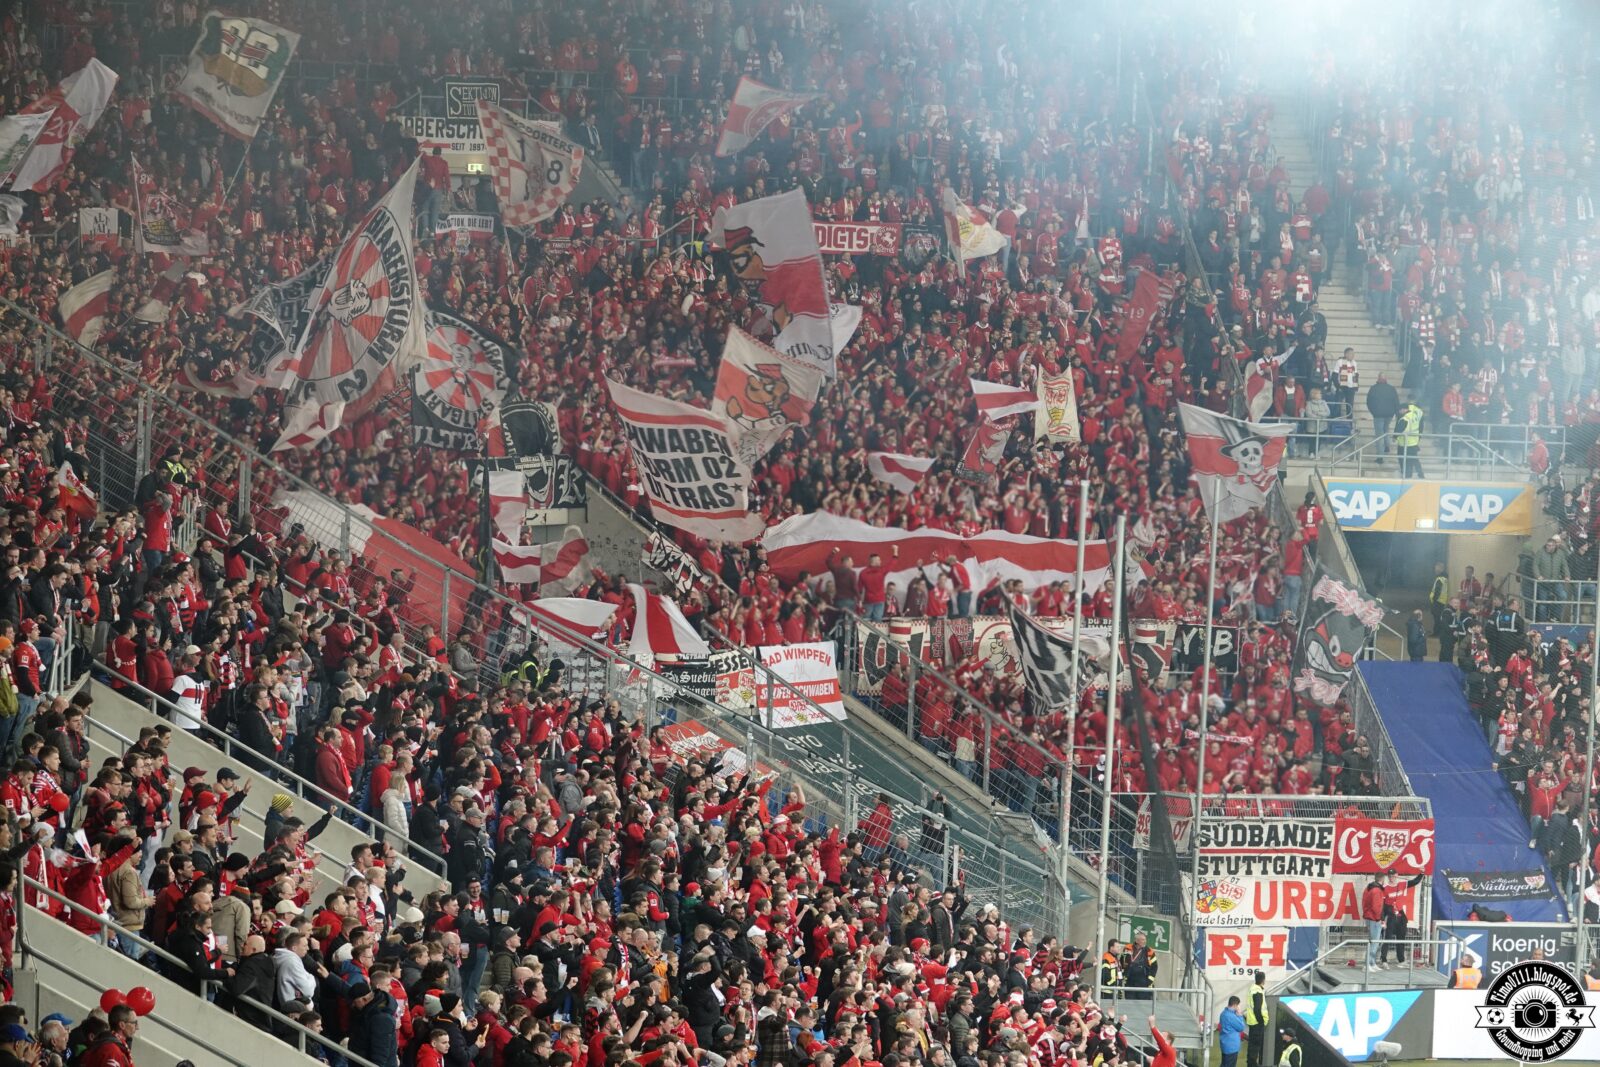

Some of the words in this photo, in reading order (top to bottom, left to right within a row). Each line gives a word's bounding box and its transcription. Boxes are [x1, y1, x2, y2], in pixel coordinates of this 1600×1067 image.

[405, 117, 483, 138] OBERSCH
[702, 455, 742, 480] 02
[645, 472, 736, 510] ULTRAS
[1328, 489, 1391, 520] SAP
[1440, 493, 1503, 523] SAP
[782, 647, 832, 667] WIMPFEN
[1200, 822, 1333, 849] SÜDBANDE
[1198, 855, 1330, 878] STUTTGART
[1254, 880, 1414, 922] URBA
[1182, 913, 1254, 925] Gndelsheim
[1208, 933, 1288, 966] RH
[1492, 933, 1560, 956] koenig.
